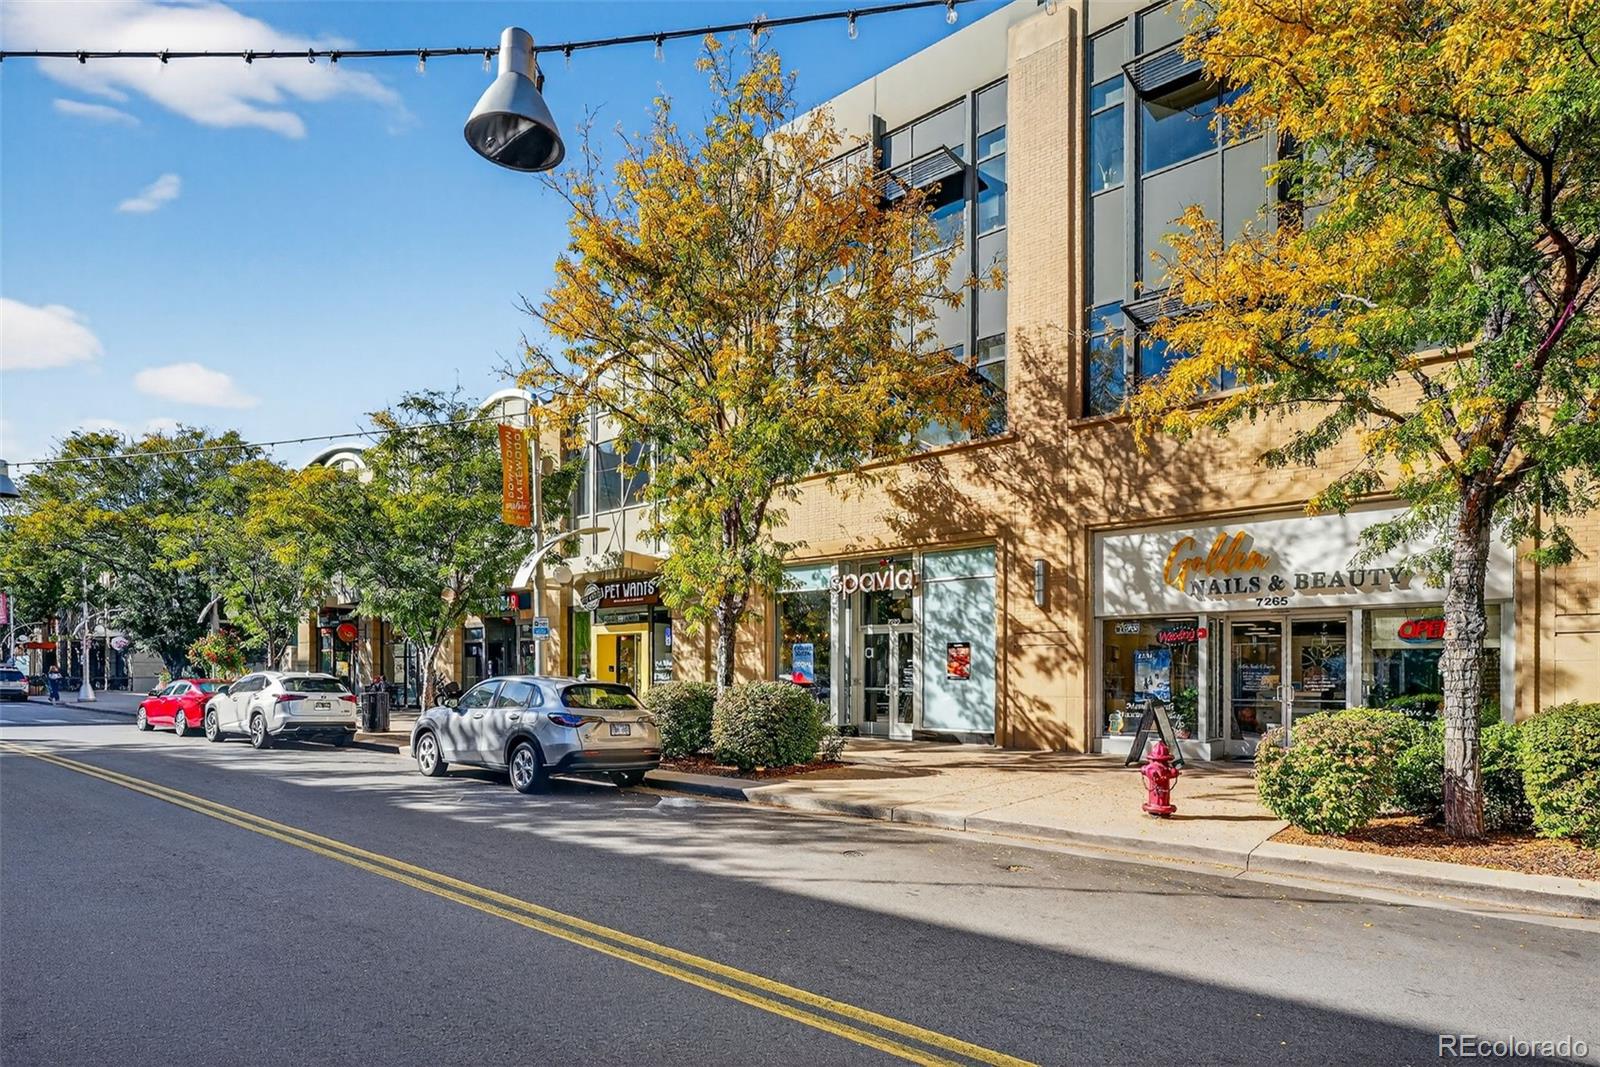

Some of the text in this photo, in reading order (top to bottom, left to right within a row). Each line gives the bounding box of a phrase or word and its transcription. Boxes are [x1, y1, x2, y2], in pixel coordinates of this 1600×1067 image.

[505, 431, 514, 498] DOWNTOWN
[514, 433, 524, 500] LAKEWOOD
[1163, 530, 1271, 592] Golden
[604, 584, 620, 599] PET
[622, 580, 655, 598] WANTS
[830, 564, 913, 600] spavia
[1190, 566, 1404, 597] NAILS & BEAUTY
[1256, 596, 1288, 607] 7265
